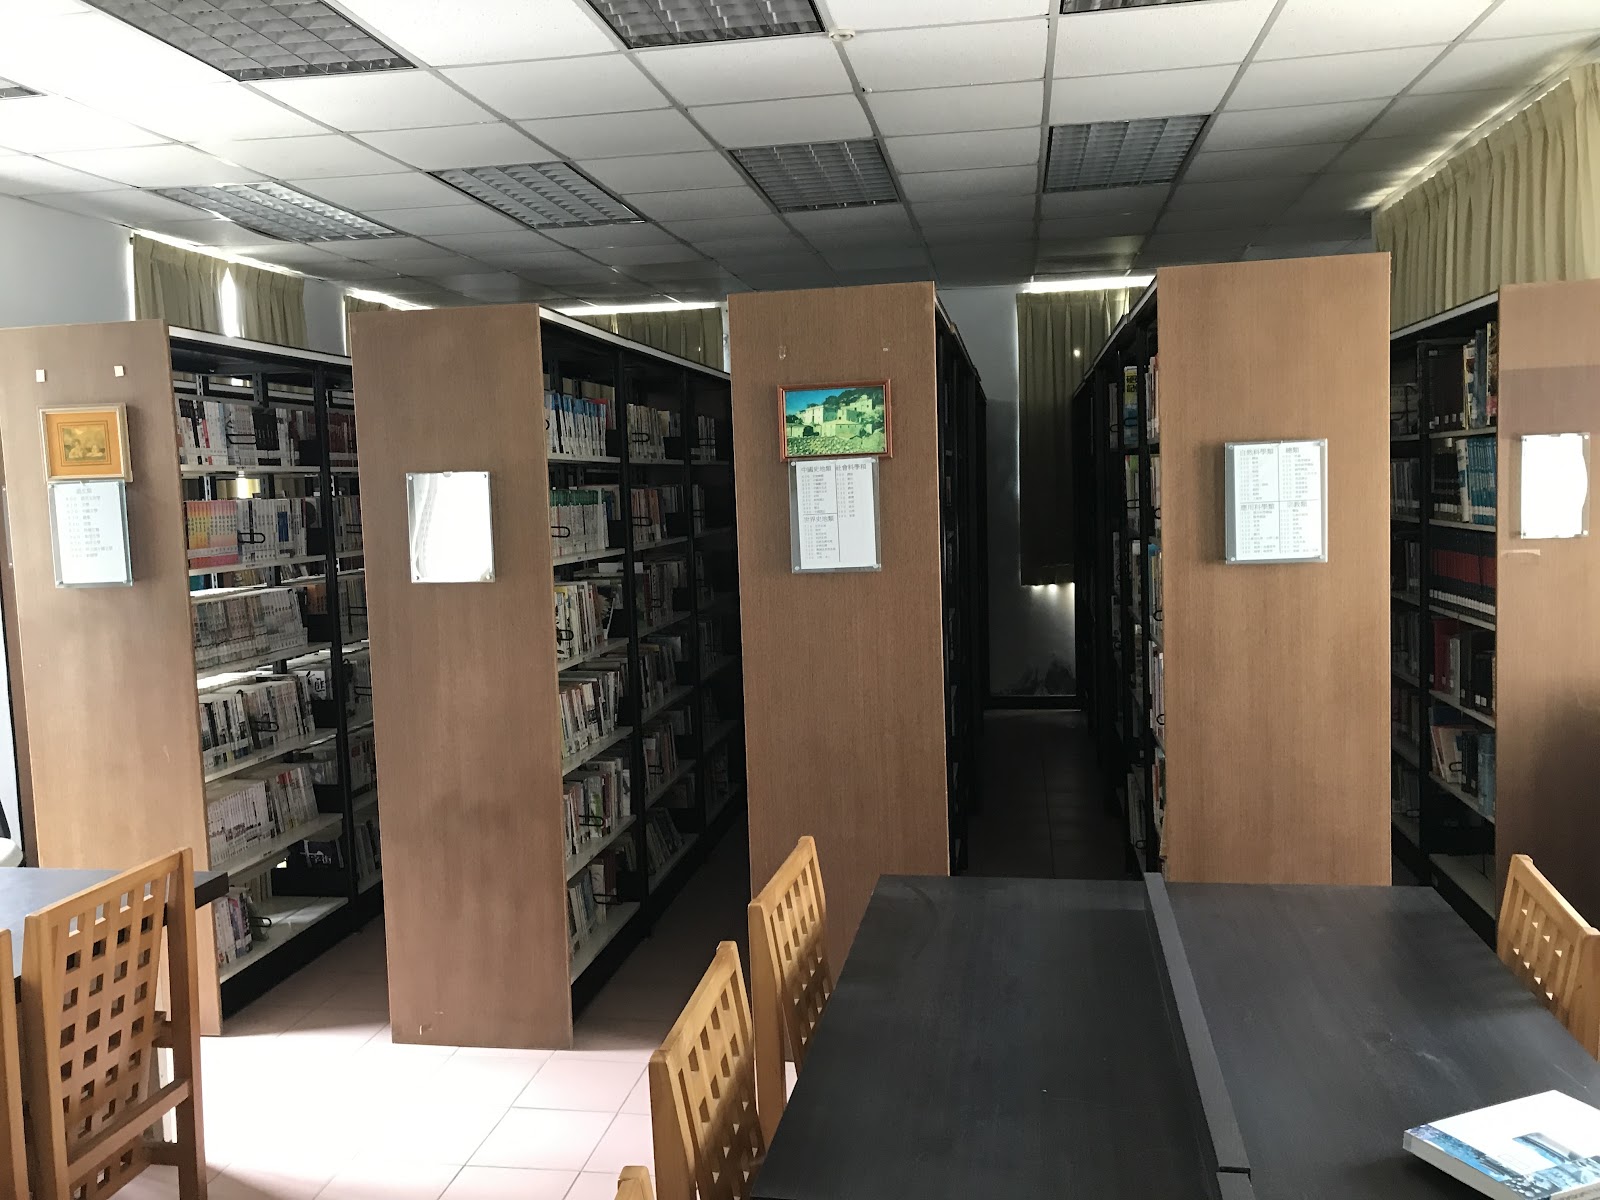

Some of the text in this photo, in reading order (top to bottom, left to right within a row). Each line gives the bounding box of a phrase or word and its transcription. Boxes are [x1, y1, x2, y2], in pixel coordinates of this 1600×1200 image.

[1240, 448, 1274, 456] 自然科學類
[801, 465, 832, 473] 中國史地類
[1240, 503, 1275, 511] 應用科學類
